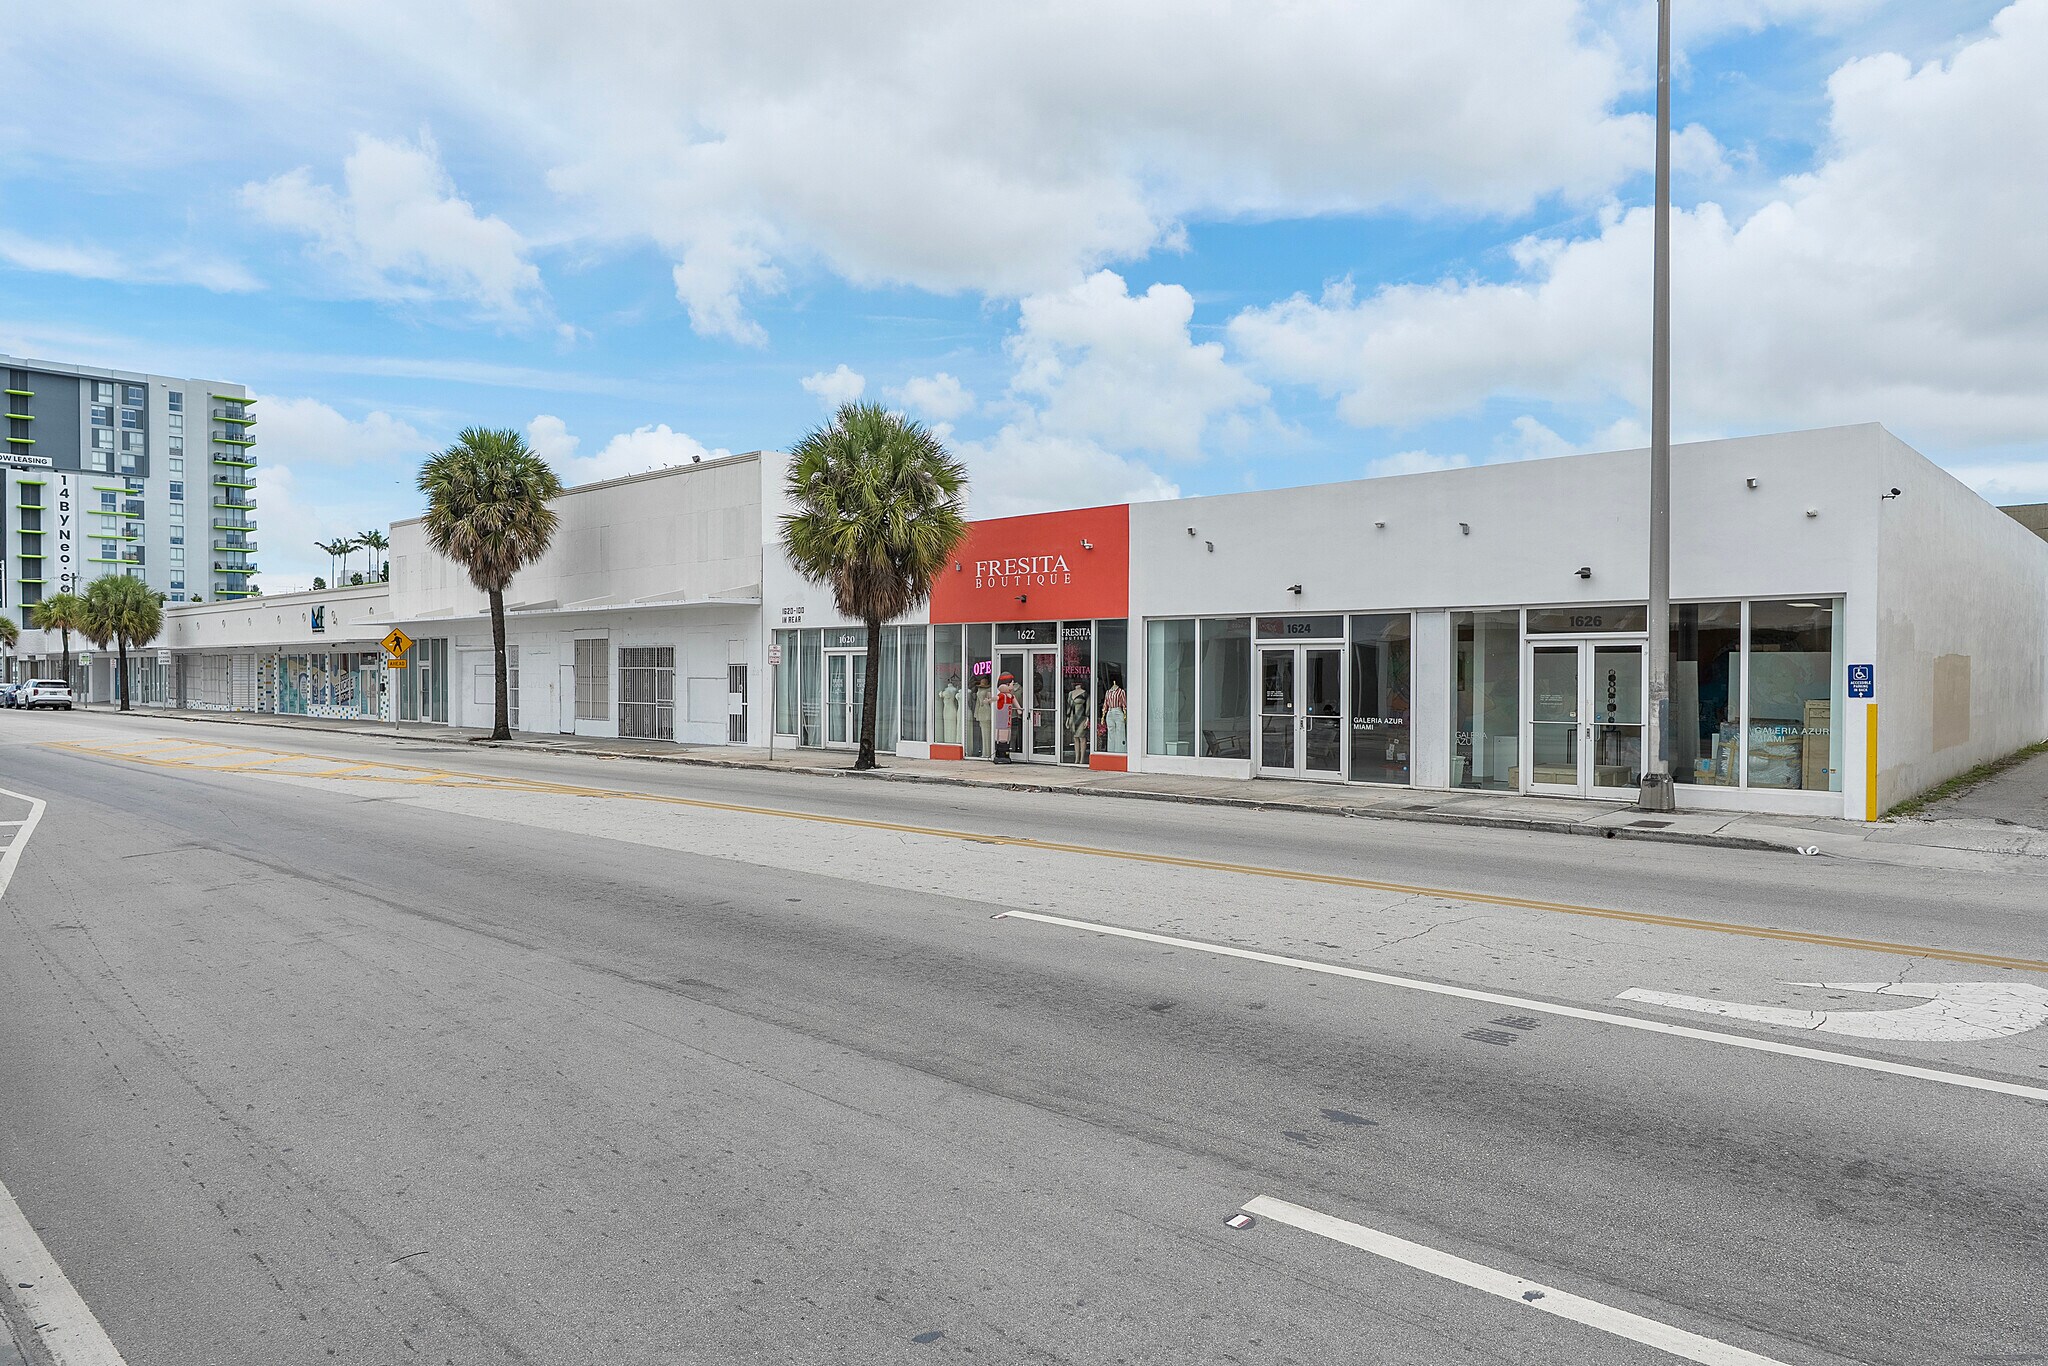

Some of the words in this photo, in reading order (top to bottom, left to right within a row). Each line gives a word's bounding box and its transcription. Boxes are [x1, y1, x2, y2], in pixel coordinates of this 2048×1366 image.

[14, 456, 47, 464] LEASING
[59, 475, 70, 593] 14ByNeo.co
[975, 555, 1070, 577] FRESITA
[975, 573, 1071, 589] BOUTIQUE
[782, 607, 804, 615] 1620-100
[1569, 615, 1602, 627] 1626
[1061, 628, 1091, 637] FRESITA
[1287, 623, 1311, 633] 1624
[839, 634, 855, 643] 1620
[1017, 630, 1035, 640] 1622
[973, 661, 992, 675] OPE
[1061, 666, 1091, 674] FRESITA
[1455, 731, 1488, 739] GALERA
[1754, 727, 1798, 735] GALERIA
